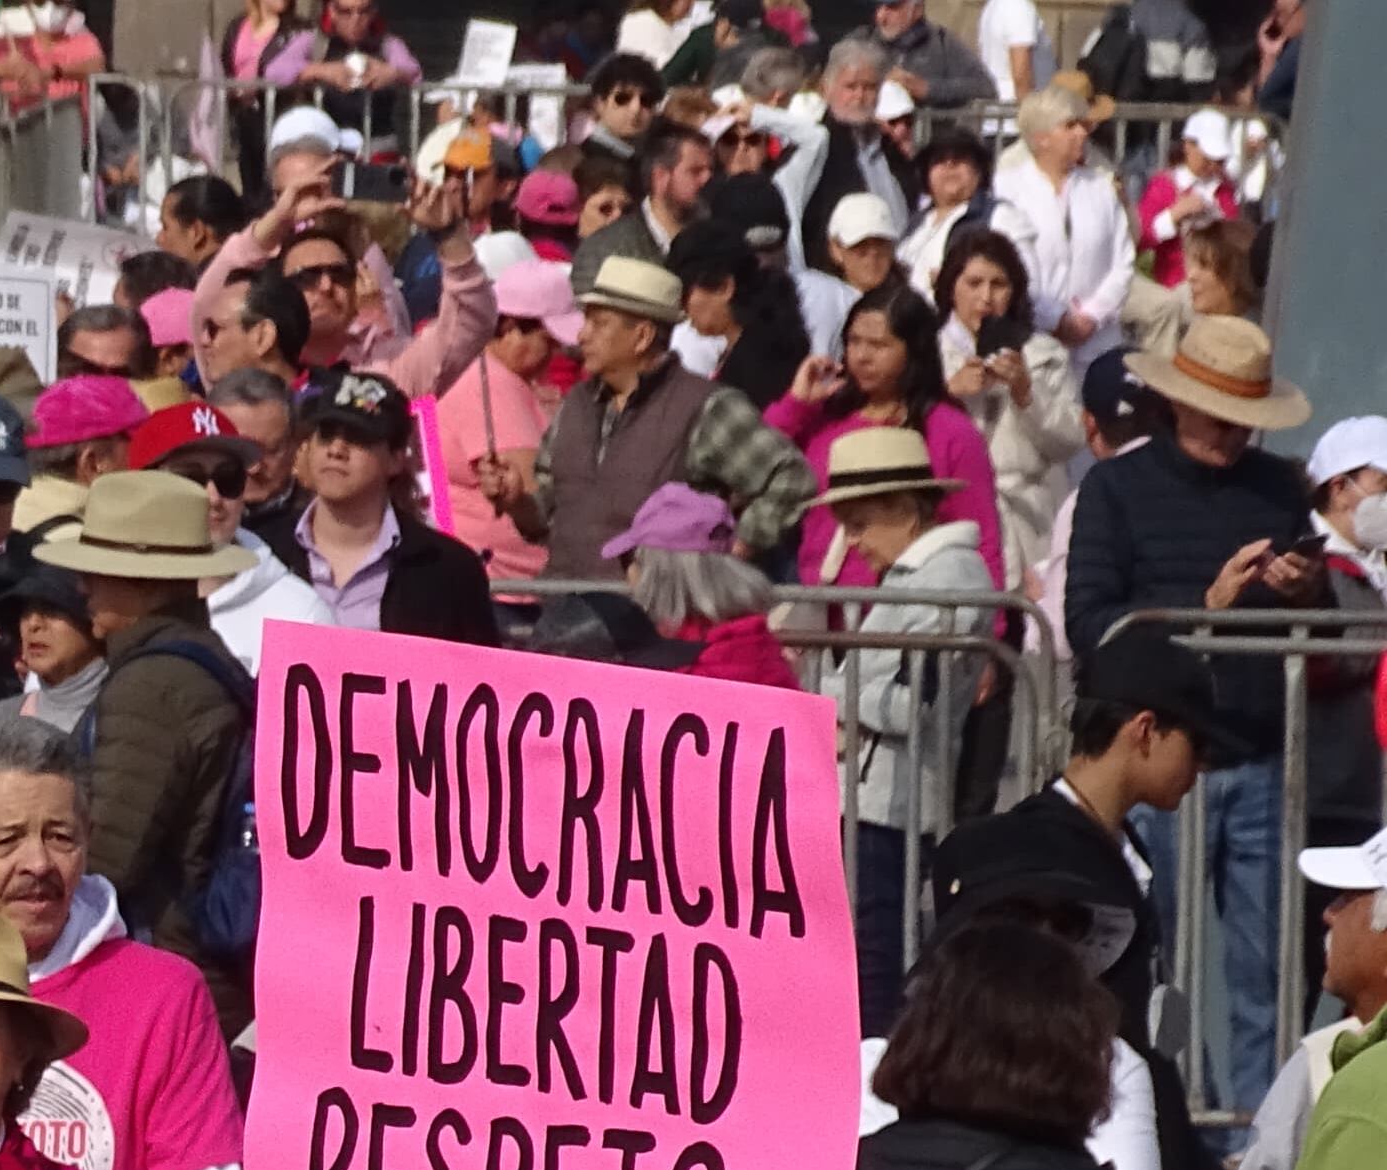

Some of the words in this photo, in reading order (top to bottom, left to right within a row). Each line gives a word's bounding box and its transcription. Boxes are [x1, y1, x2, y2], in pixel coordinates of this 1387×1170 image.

[6, 294, 21, 311] SE
[26, 322, 39, 337] EL
[282, 664, 805, 938] DEMOCRACIA
[351, 897, 741, 1124] LIBERTAD
[22, 1120, 86, 1159] OTO
